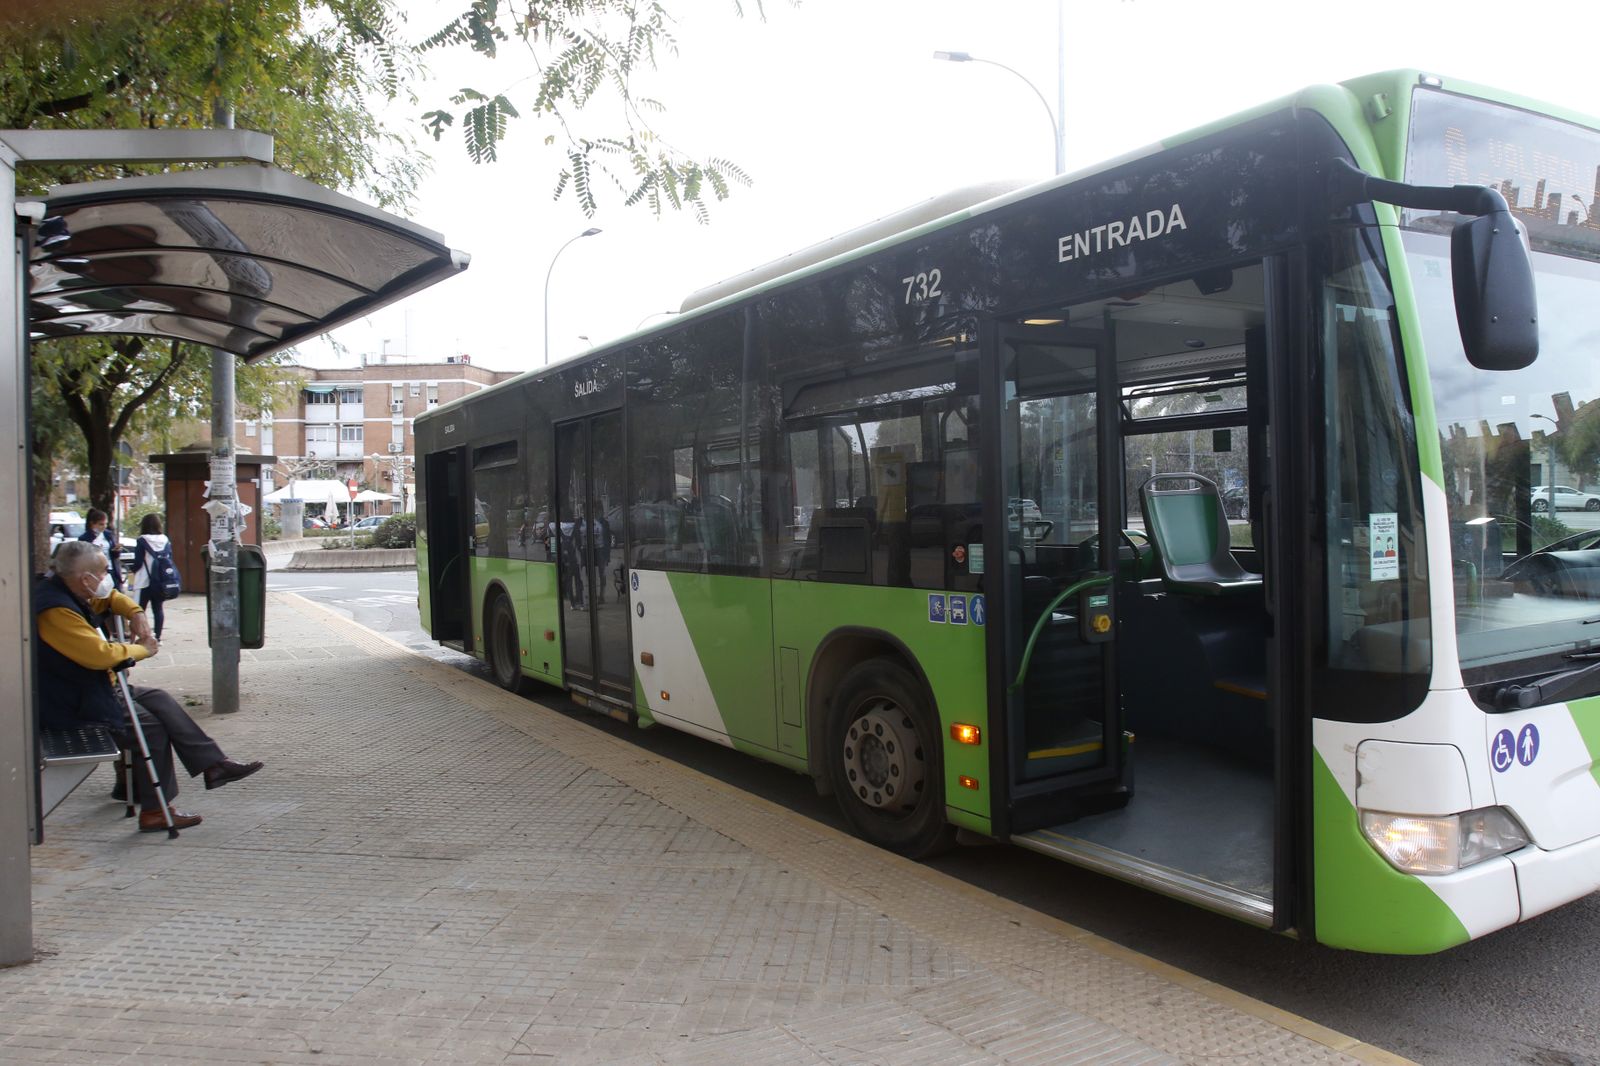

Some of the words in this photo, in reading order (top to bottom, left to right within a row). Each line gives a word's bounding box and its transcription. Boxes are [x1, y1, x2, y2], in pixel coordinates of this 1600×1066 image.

[1058, 204, 1187, 263] ENTRADA
[902, 268, 942, 305] 732
[574, 379, 598, 398] SALIDA
